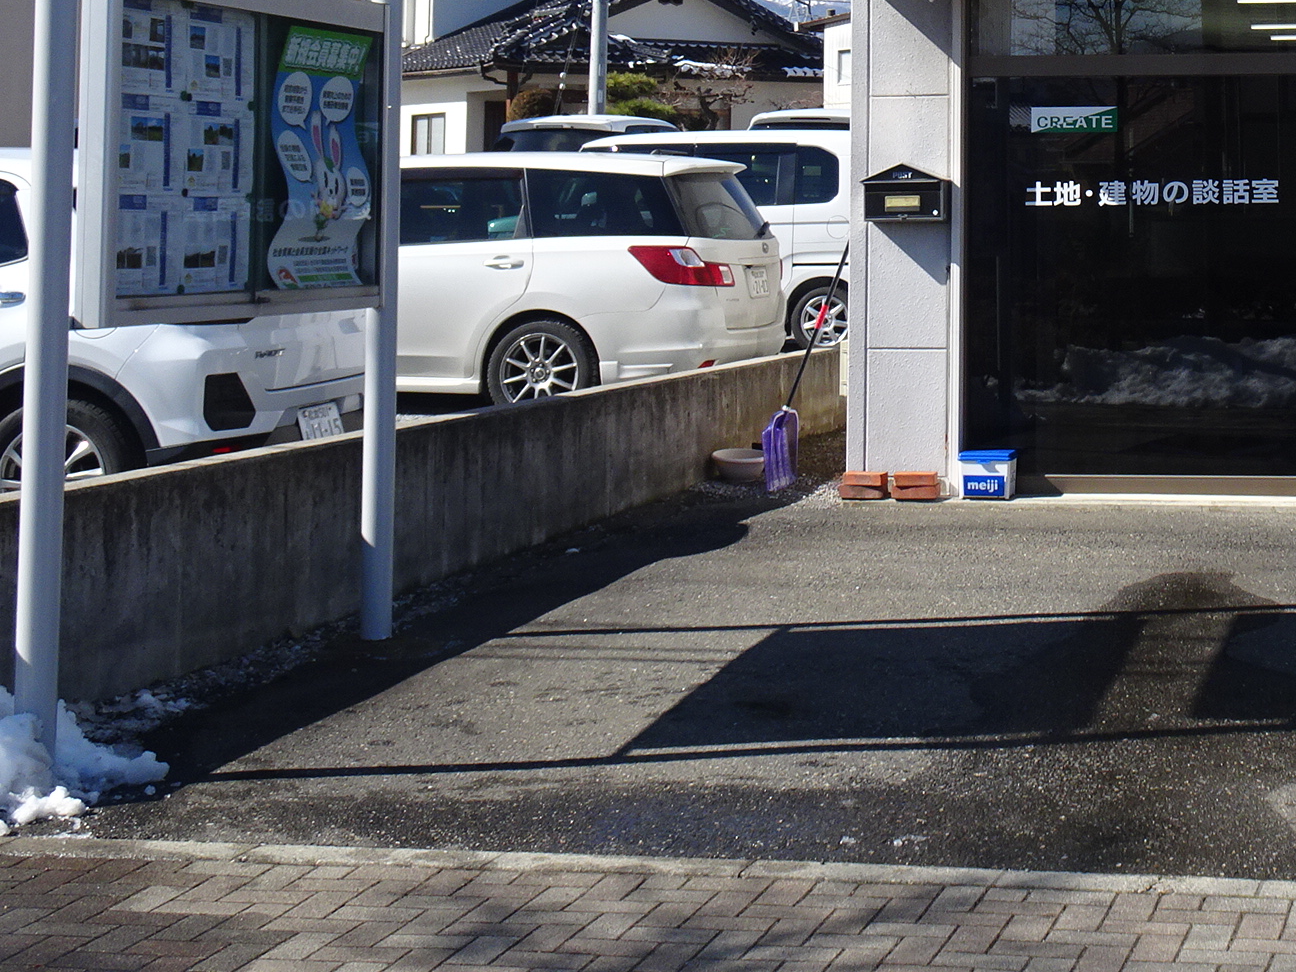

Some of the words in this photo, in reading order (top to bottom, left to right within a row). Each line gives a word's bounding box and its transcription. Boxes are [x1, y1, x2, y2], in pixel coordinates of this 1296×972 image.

[1036, 114, 1114, 129] CREATE
[1025, 178, 1280, 207] 土地・建物の談話室
[966, 478, 999, 493] meiji
